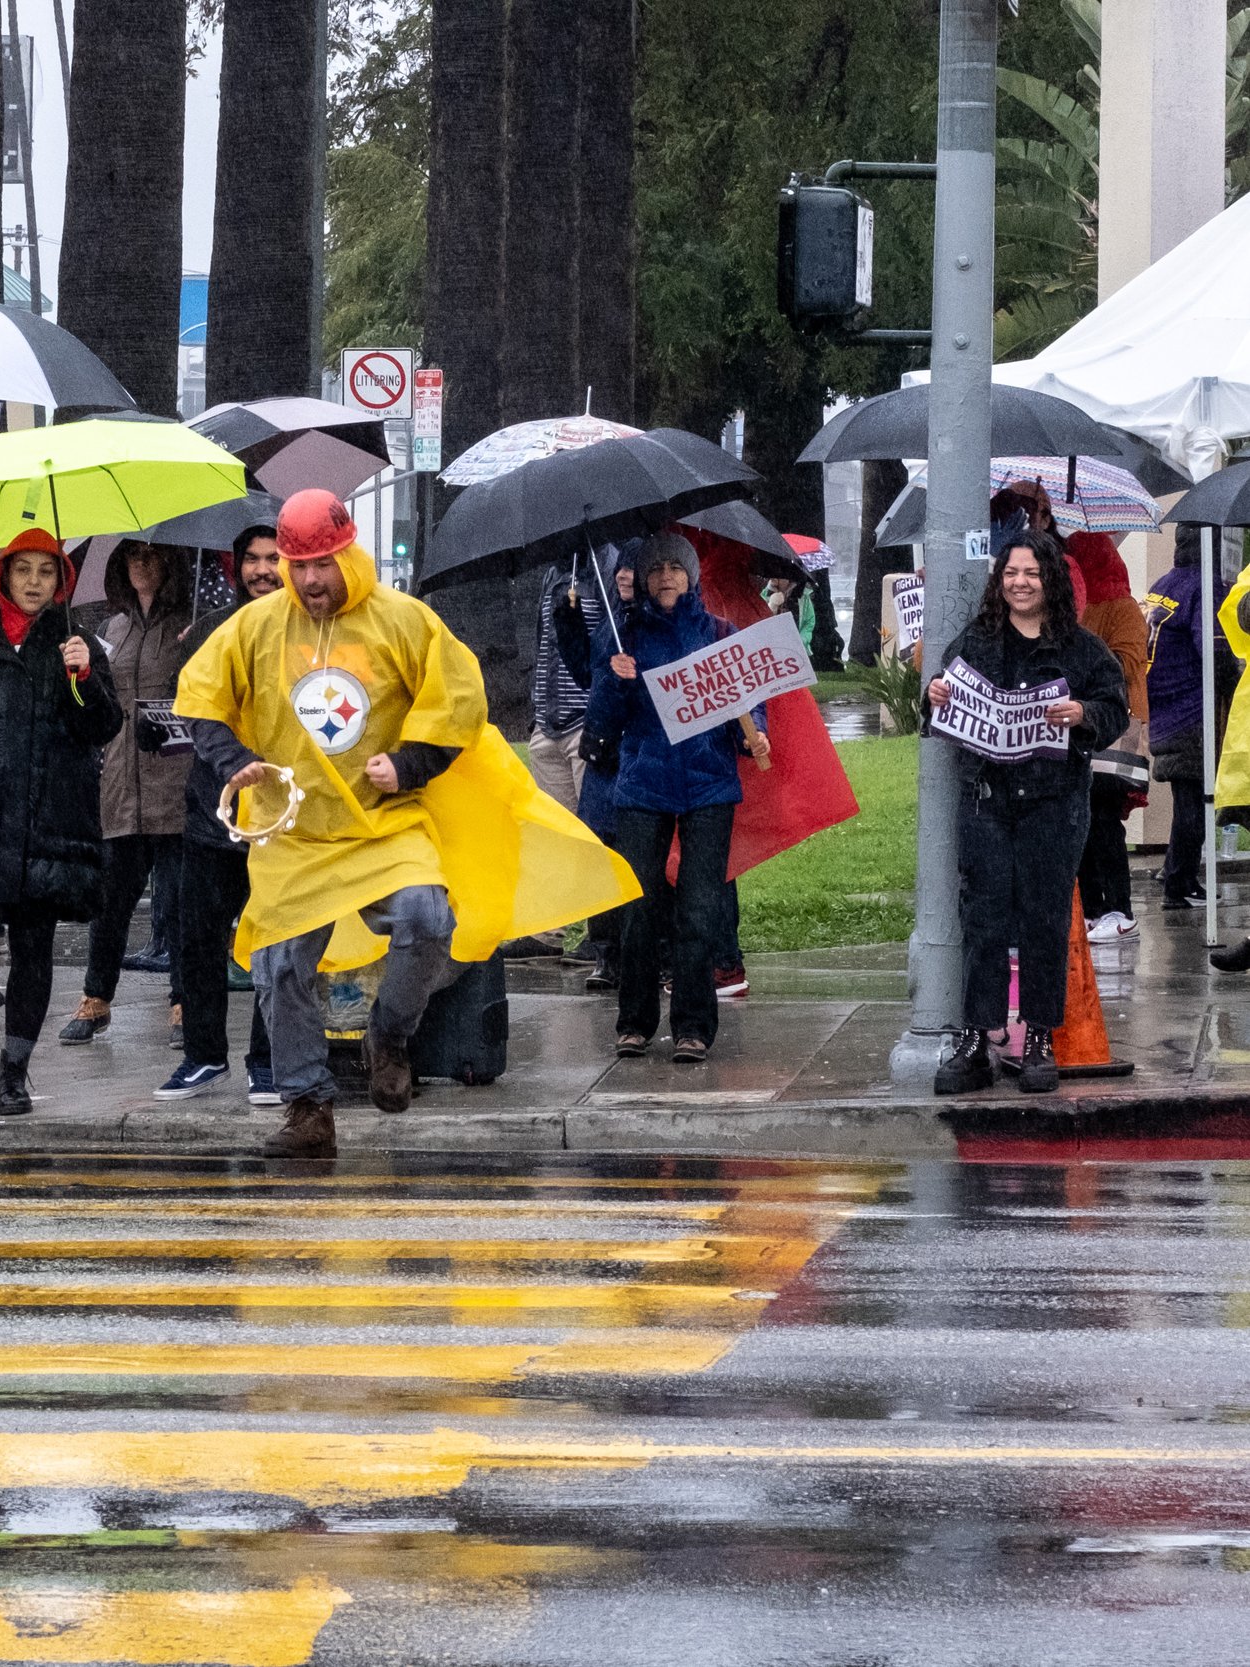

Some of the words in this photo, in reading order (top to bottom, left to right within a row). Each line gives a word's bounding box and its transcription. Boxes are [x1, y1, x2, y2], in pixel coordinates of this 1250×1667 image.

[356, 375, 400, 387] LITTERING
[896, 578, 922, 592] FIGHTI
[899, 592, 923, 612] EAN,
[657, 667, 692, 693] WE
[693, 643, 745, 679] NEED
[682, 646, 775, 703] SMALLER
[953, 663, 981, 690] READY
[982, 684, 993, 698] TO
[995, 692, 1035, 705] STRIKE
[1038, 685, 1060, 700] FOR
[676, 686, 741, 724] CLASS
[742, 657, 800, 694] SIZES
[299, 706, 326, 715] Steelers
[937, 702, 999, 748] BETTER
[1006, 721, 1064, 749] LIVES!
[996, 703, 1060, 726] SCHOOL
